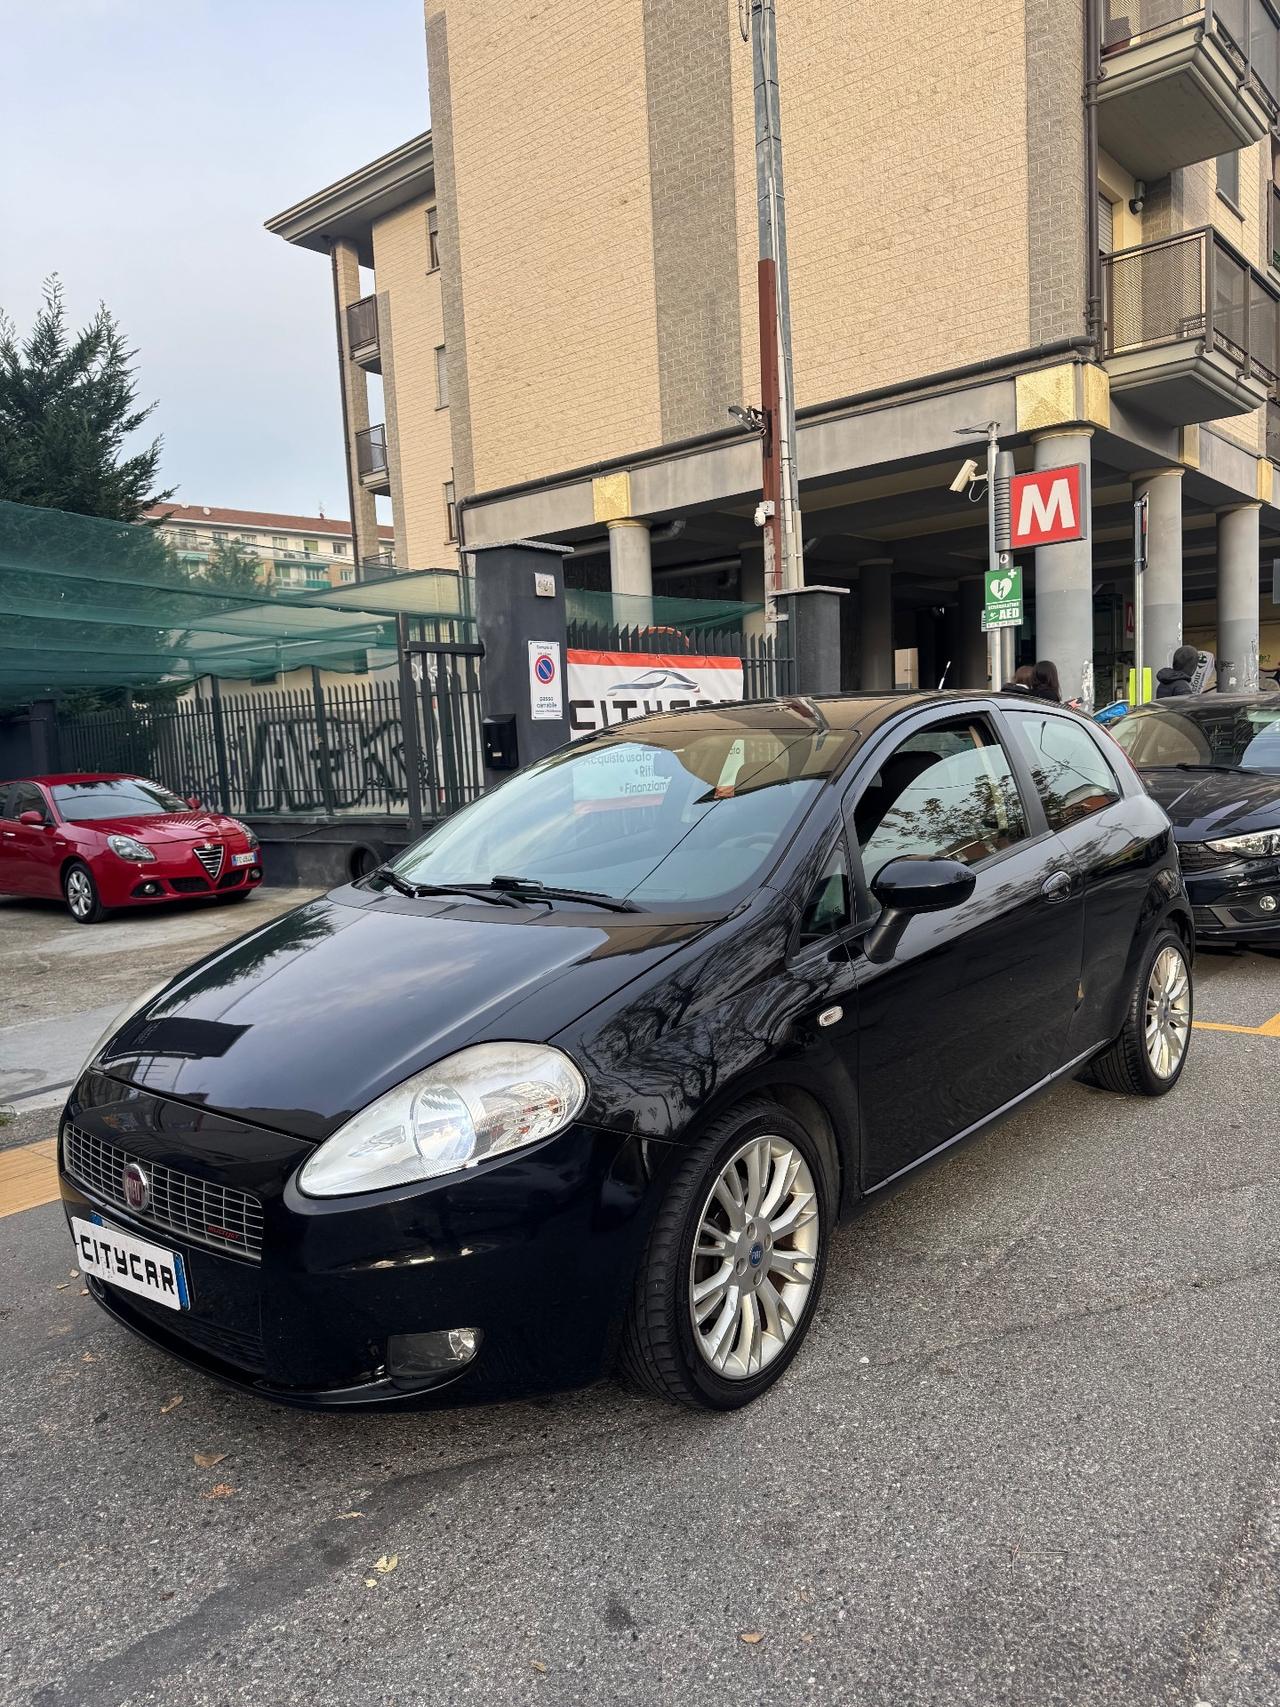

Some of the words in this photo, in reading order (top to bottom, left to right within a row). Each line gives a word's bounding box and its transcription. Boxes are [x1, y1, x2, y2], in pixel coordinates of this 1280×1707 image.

[1017, 478, 1076, 536] M
[999, 608, 1020, 620] AED
[626, 752, 652, 762] usato
[625, 781, 668, 794] Finanziam
[80, 1234, 175, 1295] CITYCAR
